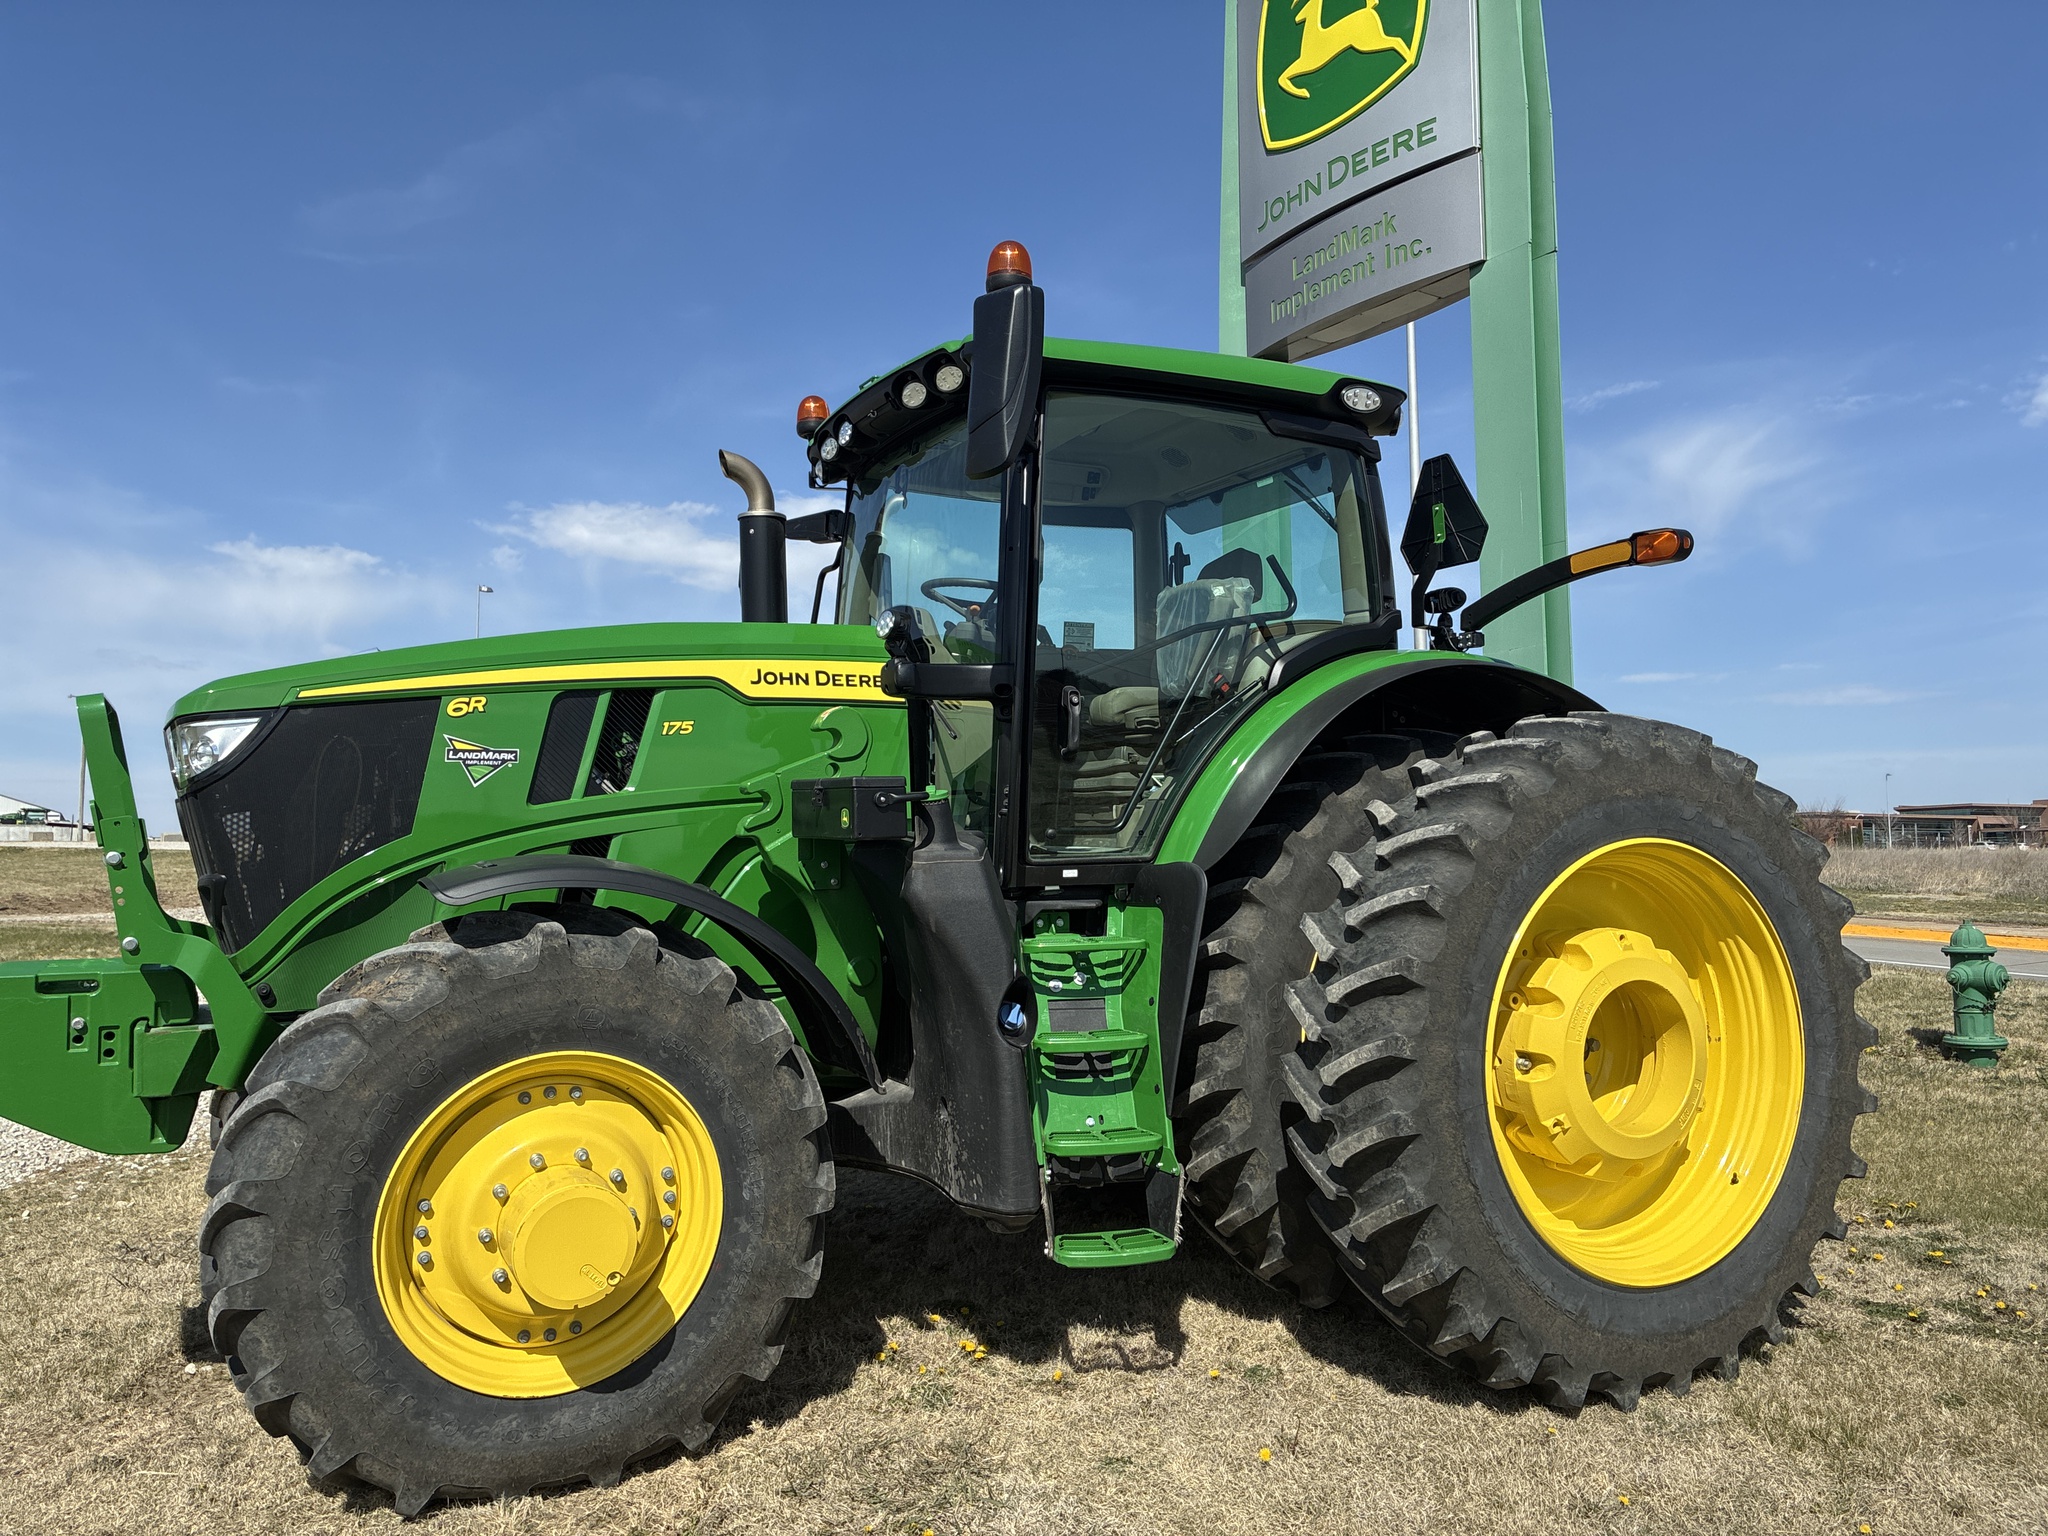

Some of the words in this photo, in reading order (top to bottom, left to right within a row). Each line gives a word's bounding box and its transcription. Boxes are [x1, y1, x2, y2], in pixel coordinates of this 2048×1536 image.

[1257, 173, 1322, 233] JOHN
[1327, 116, 1438, 190] DEERE
[1292, 211, 1398, 281] LandMark
[1270, 252, 1376, 324] Implement
[1384, 238, 1432, 269] Inc.
[750, 668, 810, 686] JOHN
[815, 670, 882, 688] DEERE
[446, 696, 488, 718] 6R
[661, 720, 695, 736] 175
[448, 750, 516, 760] LANDMARK
